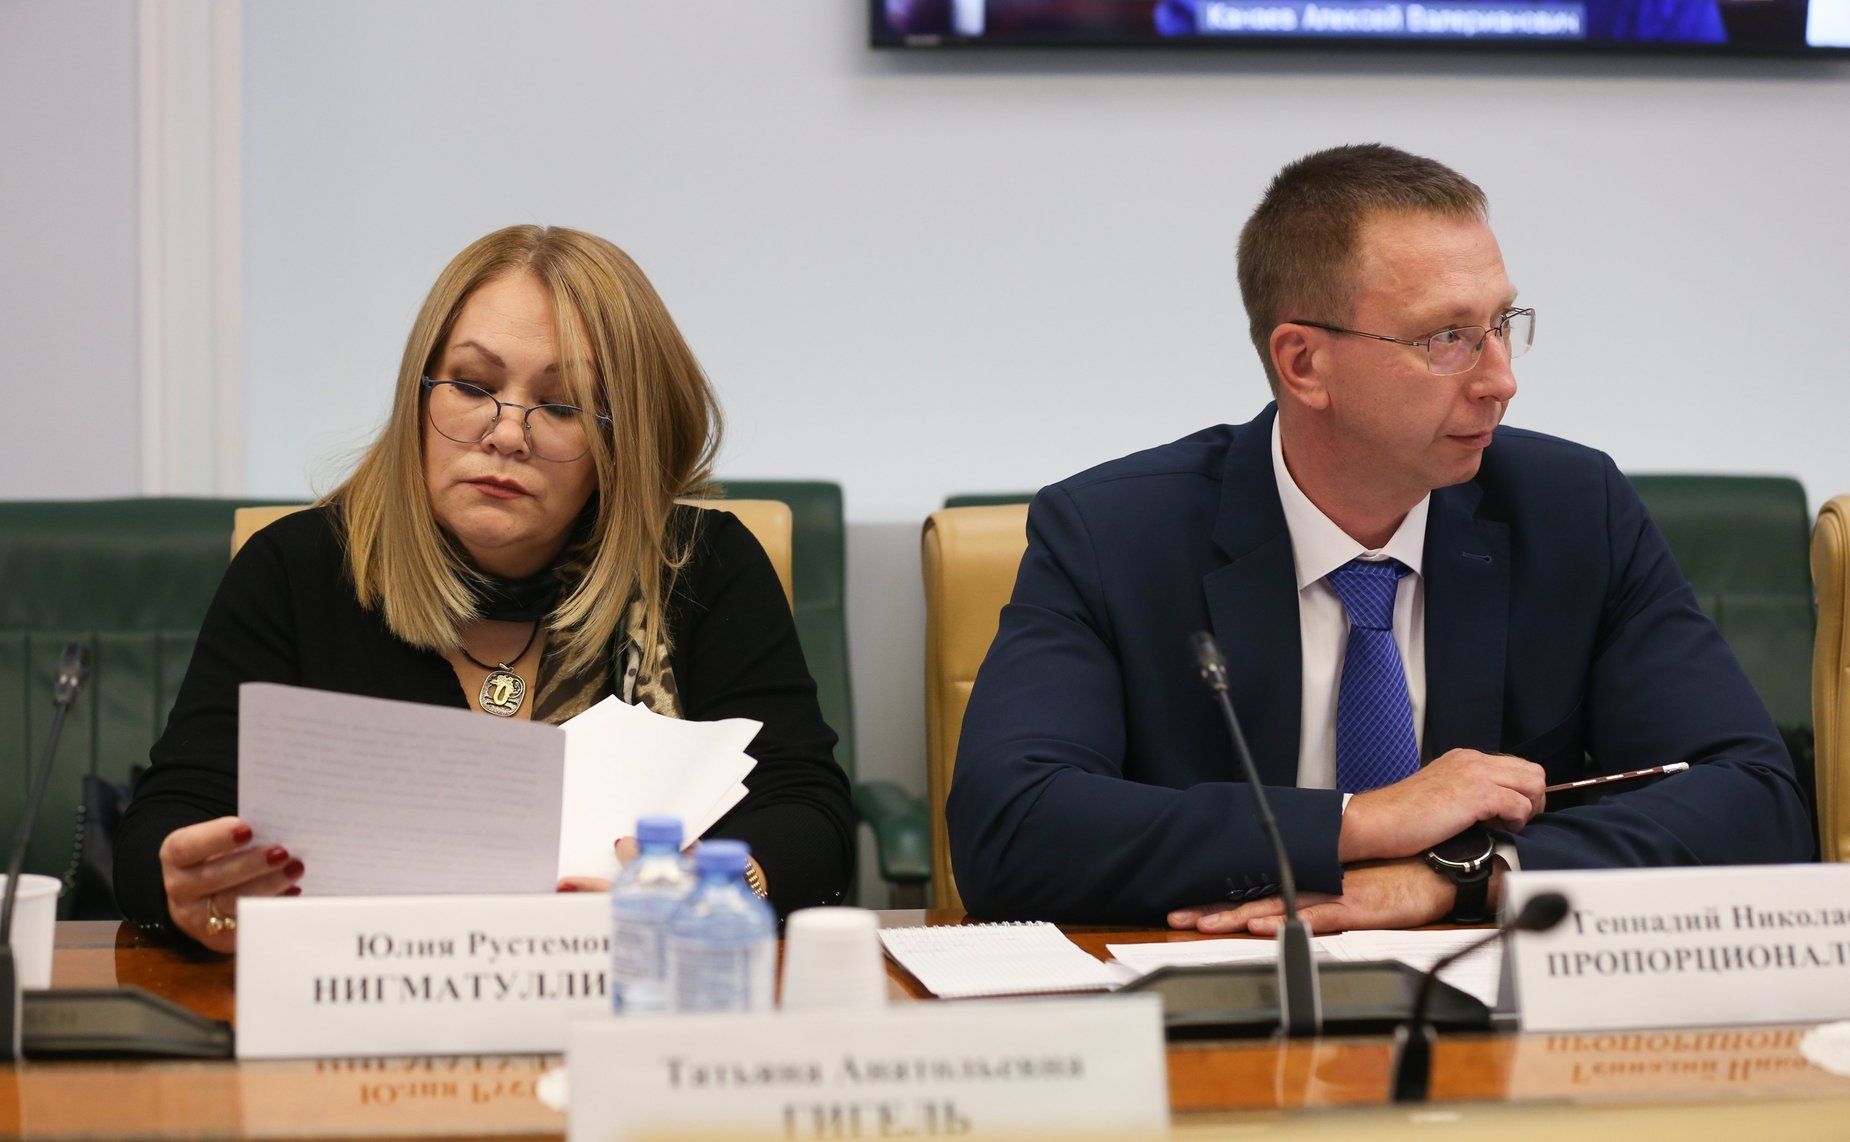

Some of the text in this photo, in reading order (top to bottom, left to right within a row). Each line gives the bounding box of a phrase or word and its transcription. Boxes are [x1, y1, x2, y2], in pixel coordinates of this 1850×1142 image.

[1301, 3, 1403, 32] Алексей
[1572, 902, 1850, 935] Геннадий Никола
[356, 931, 455, 959] Юлия
[1546, 940, 1850, 977] ПРОПОРЦИОНАЛ
[664, 1052, 1085, 1090] Татьяна Анатольевна
[781, 1099, 971, 1141] ГИГЕЛЬ
